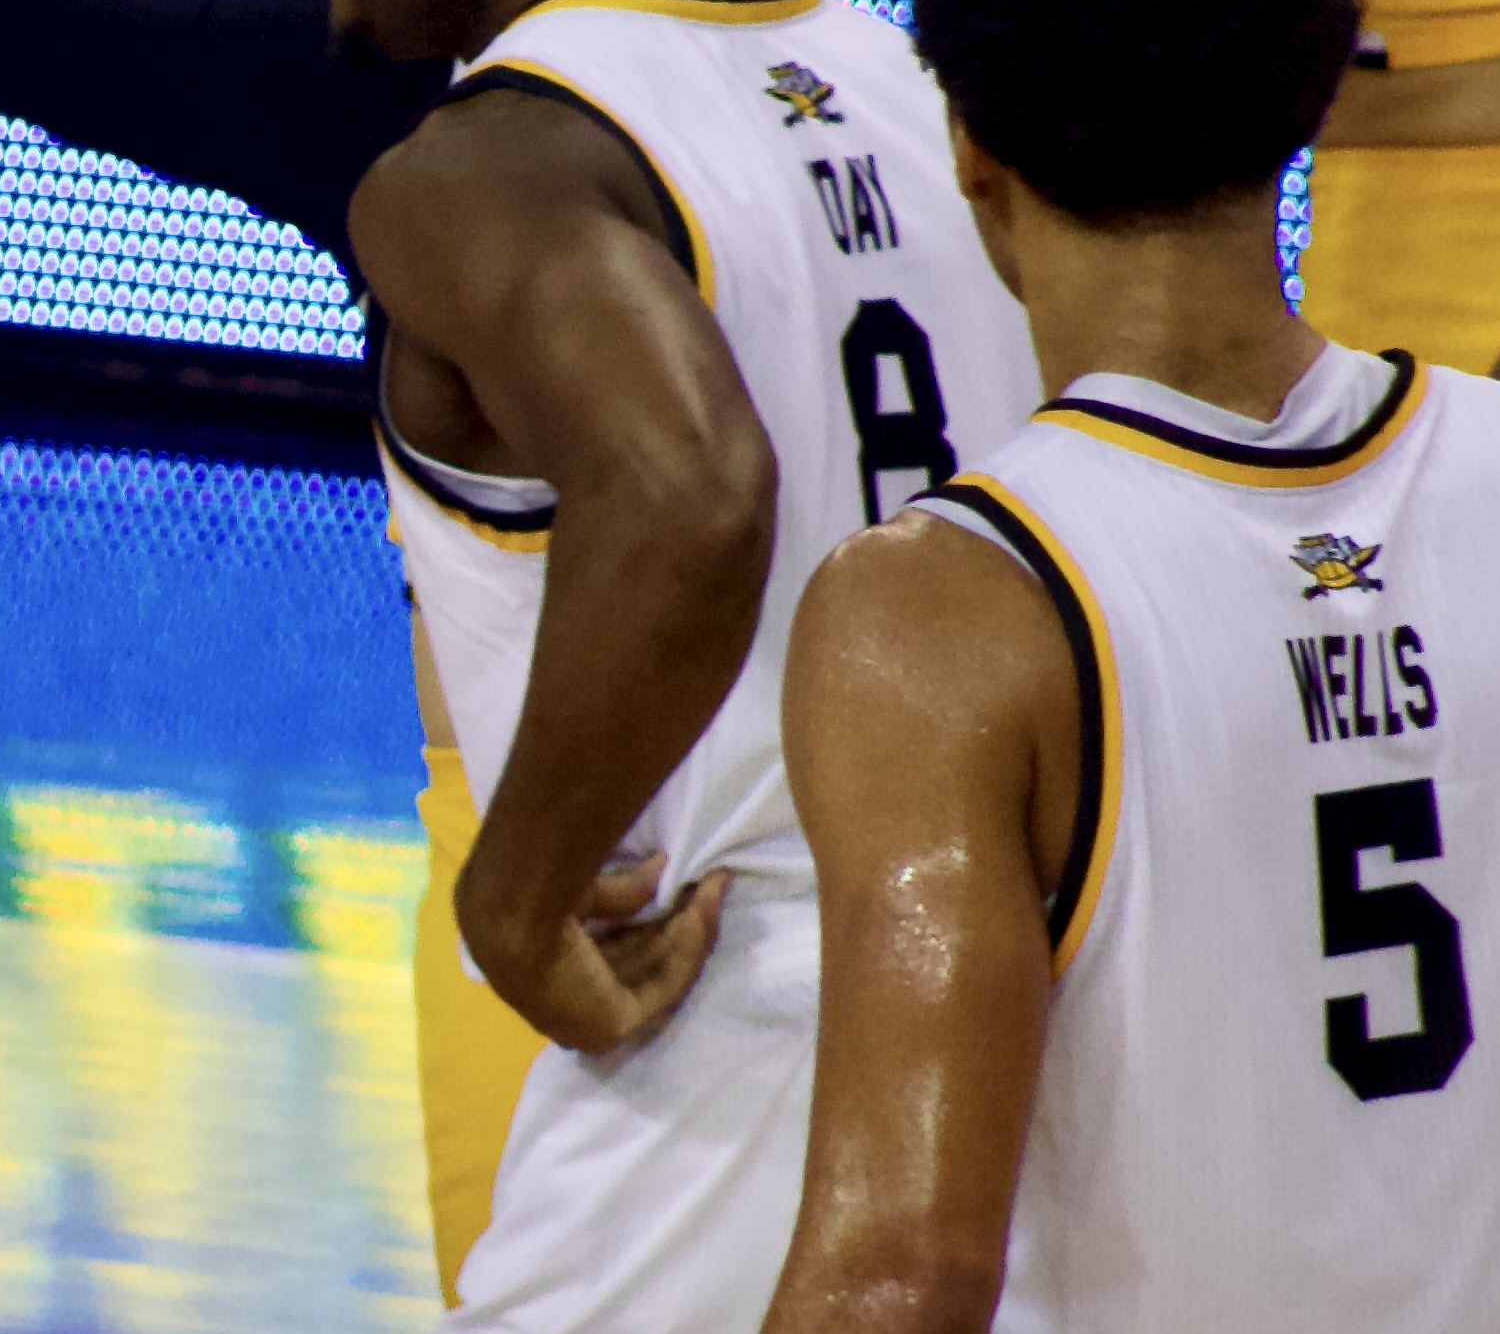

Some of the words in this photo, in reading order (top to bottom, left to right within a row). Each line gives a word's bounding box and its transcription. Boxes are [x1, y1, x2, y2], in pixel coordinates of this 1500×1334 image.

[804, 153, 900, 256] DAY
[840, 297, 959, 527] 8
[1285, 623, 1439, 744] WELLS
[1313, 776, 1475, 1104] 5
